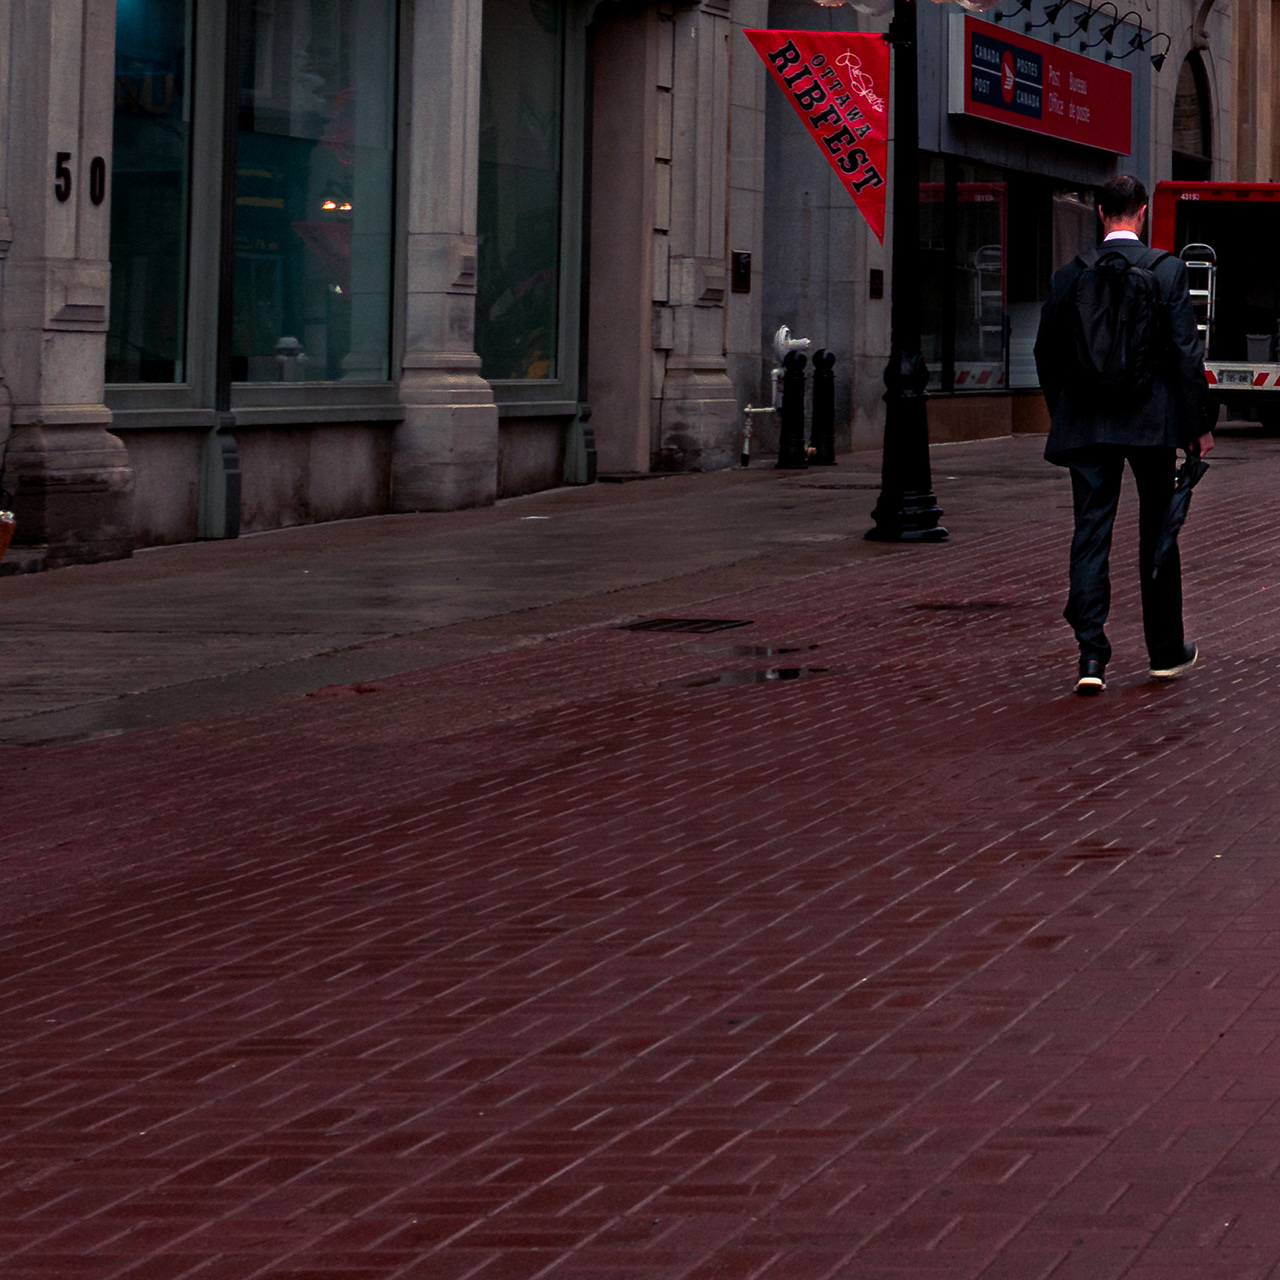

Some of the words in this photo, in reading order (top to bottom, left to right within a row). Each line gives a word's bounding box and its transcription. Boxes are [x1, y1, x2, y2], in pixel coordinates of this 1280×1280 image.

[974, 43, 1000, 65] CANADA
[1016, 57, 1038, 77] POSTES
[1048, 65, 1061, 87] Post
[974, 77, 990, 94] POST
[1069, 71, 1087, 95] Bureau
[810, 53, 873, 140] OTTAWA
[1016, 90, 1040, 108] CANADA
[1048, 92, 1064, 116] Office
[766, 38, 886, 195] RIBFEST
[1069, 99, 1076, 119] de
[1076, 105, 1091, 124] poste
